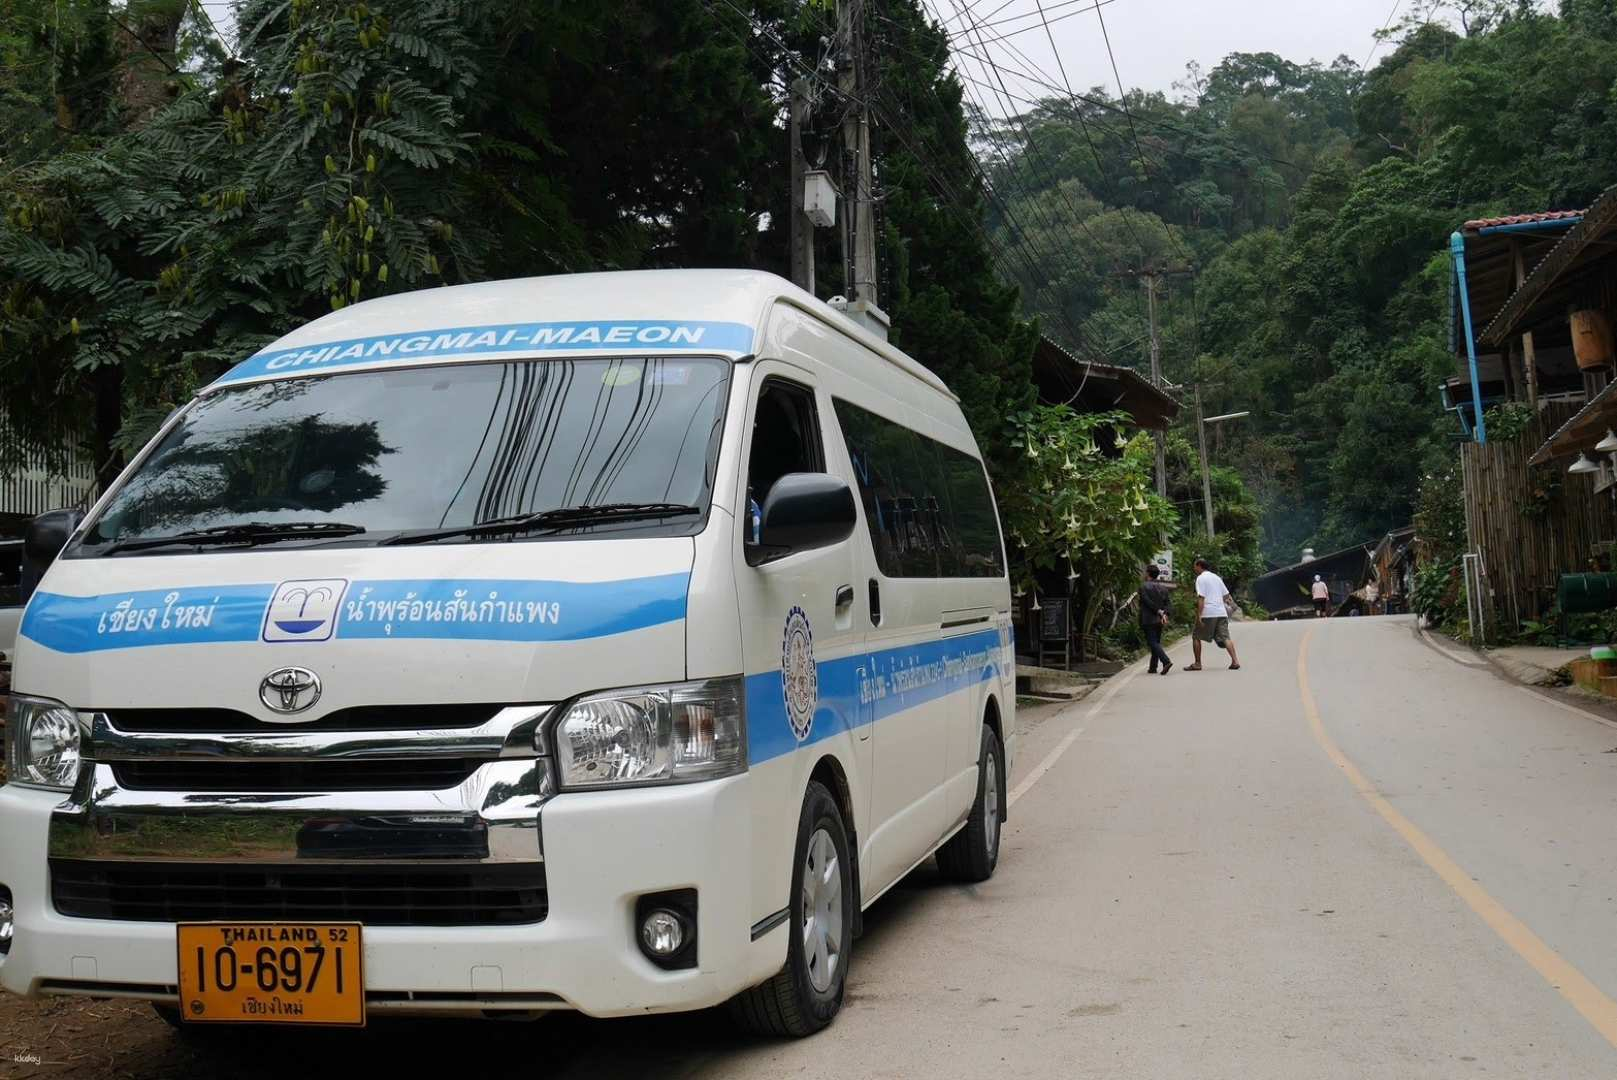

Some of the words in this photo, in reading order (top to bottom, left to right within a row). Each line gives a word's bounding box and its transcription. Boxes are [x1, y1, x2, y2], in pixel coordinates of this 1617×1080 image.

[265, 326, 706, 371] CHIANGMAI-MAEON
[347, 587, 560, 635] น้ำพุร้อนสันกำแพง
[221, 928, 318, 942] THAILAND
[329, 928, 348, 942] 52
[197, 946, 343, 994] 10-6971
[242, 997, 304, 1015] เชียงใหม่
